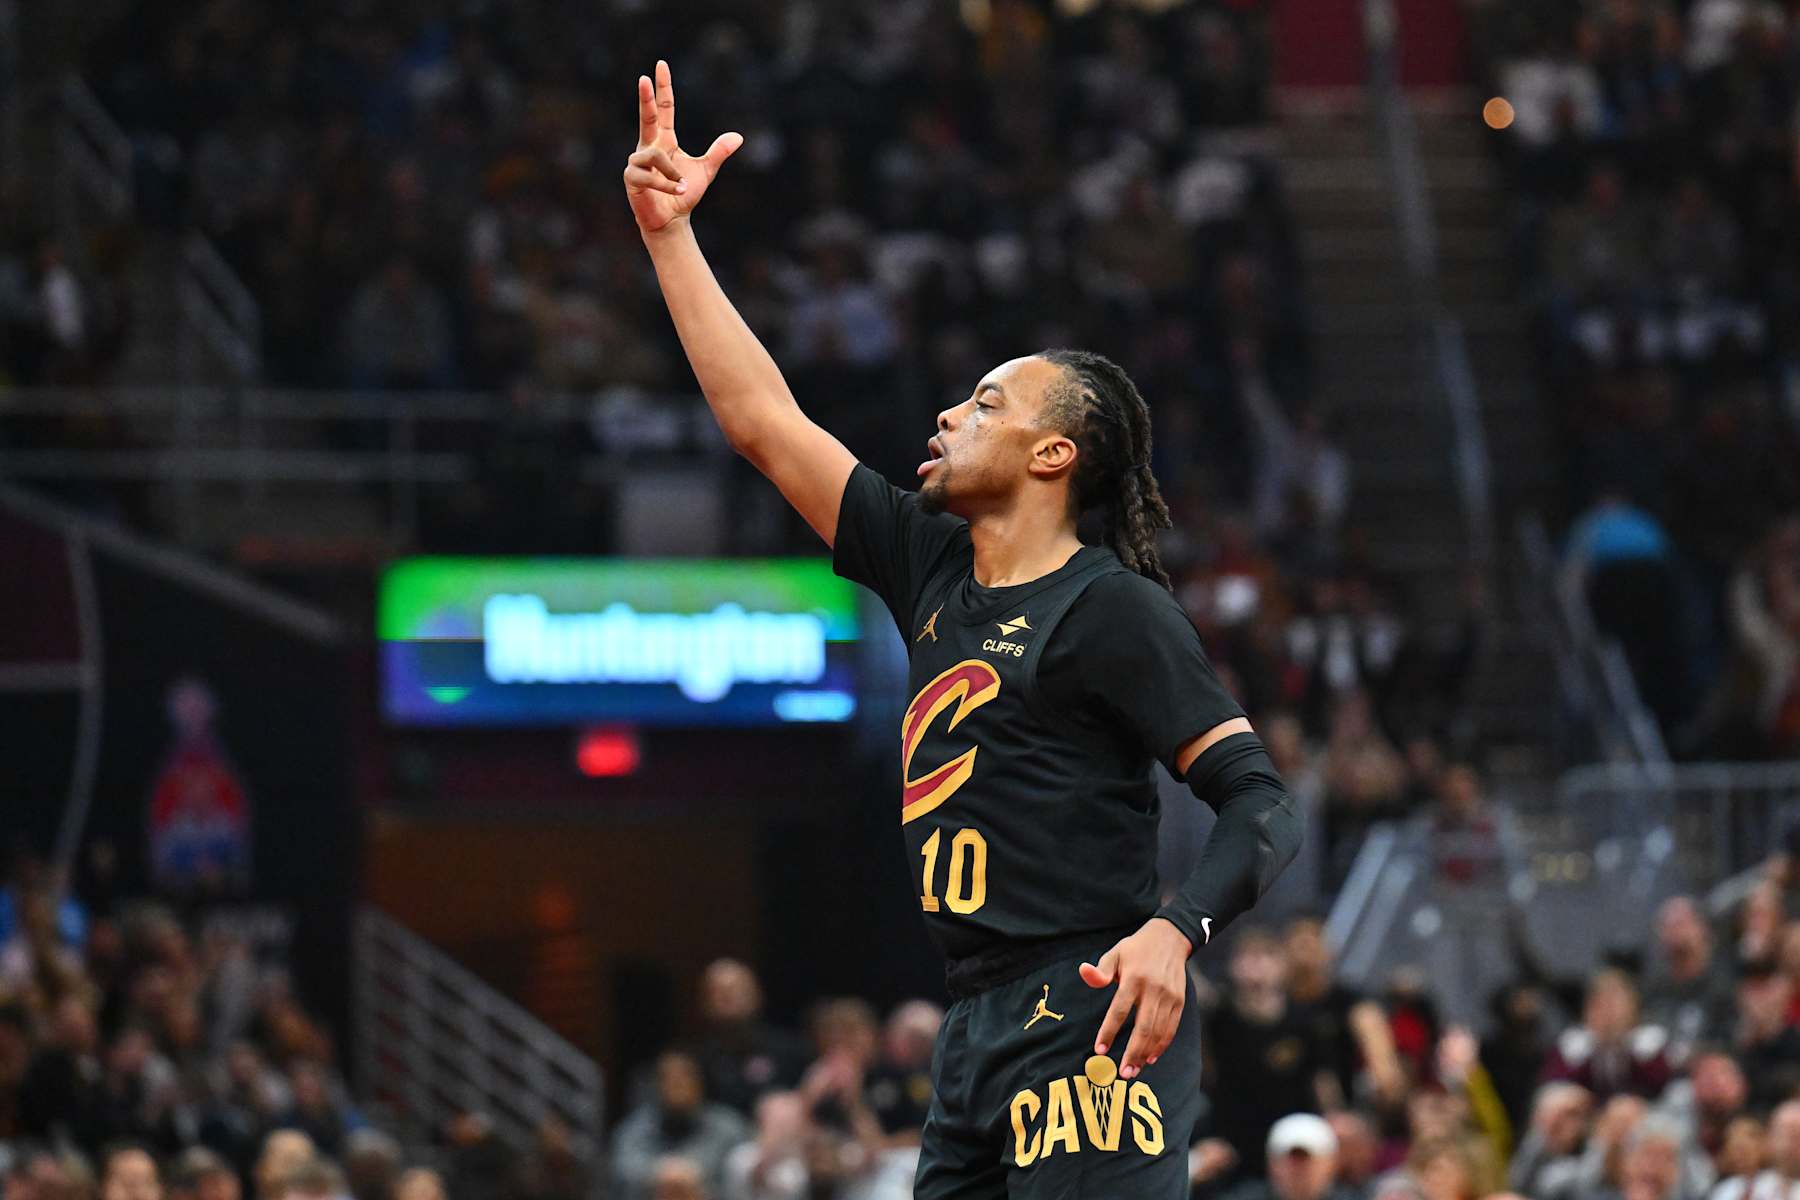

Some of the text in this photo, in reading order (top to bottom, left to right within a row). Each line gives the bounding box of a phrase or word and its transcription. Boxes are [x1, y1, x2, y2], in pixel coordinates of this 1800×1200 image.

[982, 638, 1025, 657] CLIFFS
[920, 827, 987, 915] 10
[1010, 1075, 1165, 1167] CAVS
